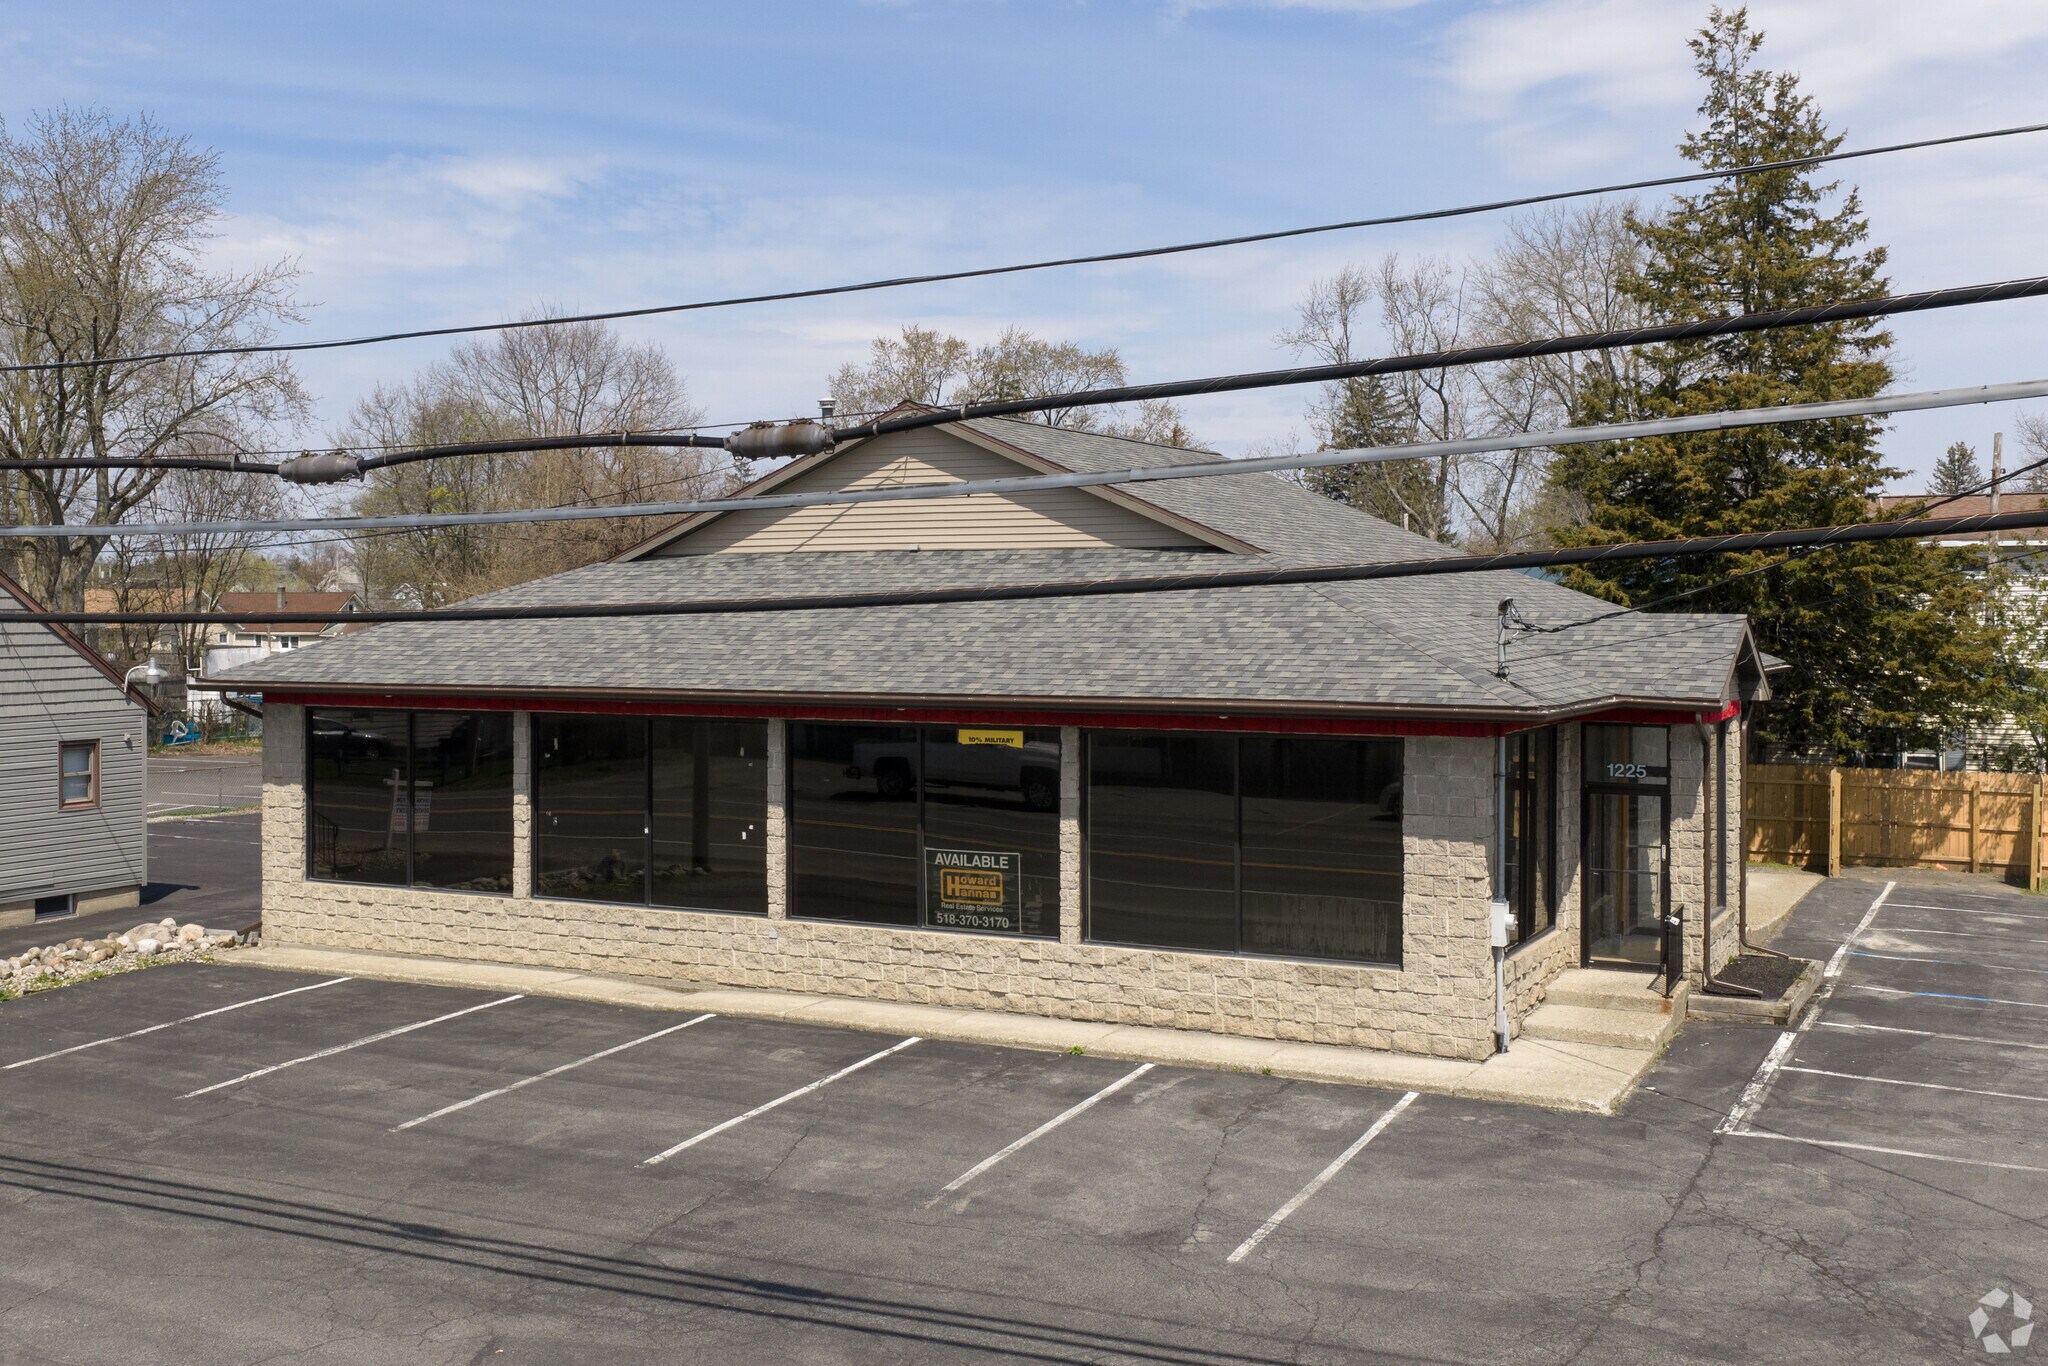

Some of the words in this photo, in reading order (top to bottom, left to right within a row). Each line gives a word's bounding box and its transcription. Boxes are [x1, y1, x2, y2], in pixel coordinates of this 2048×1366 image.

[1606, 763, 1647, 778] 1225
[935, 852, 1009, 869] AVAILABLE
[946, 875, 997, 889] Howard
[946, 884, 992, 899] Hanna
[941, 901, 955, 909] Real
[956, 903, 976, 911] Estate
[976, 904, 1004, 913] Services
[936, 912, 1009, 929] 518-370-3170
